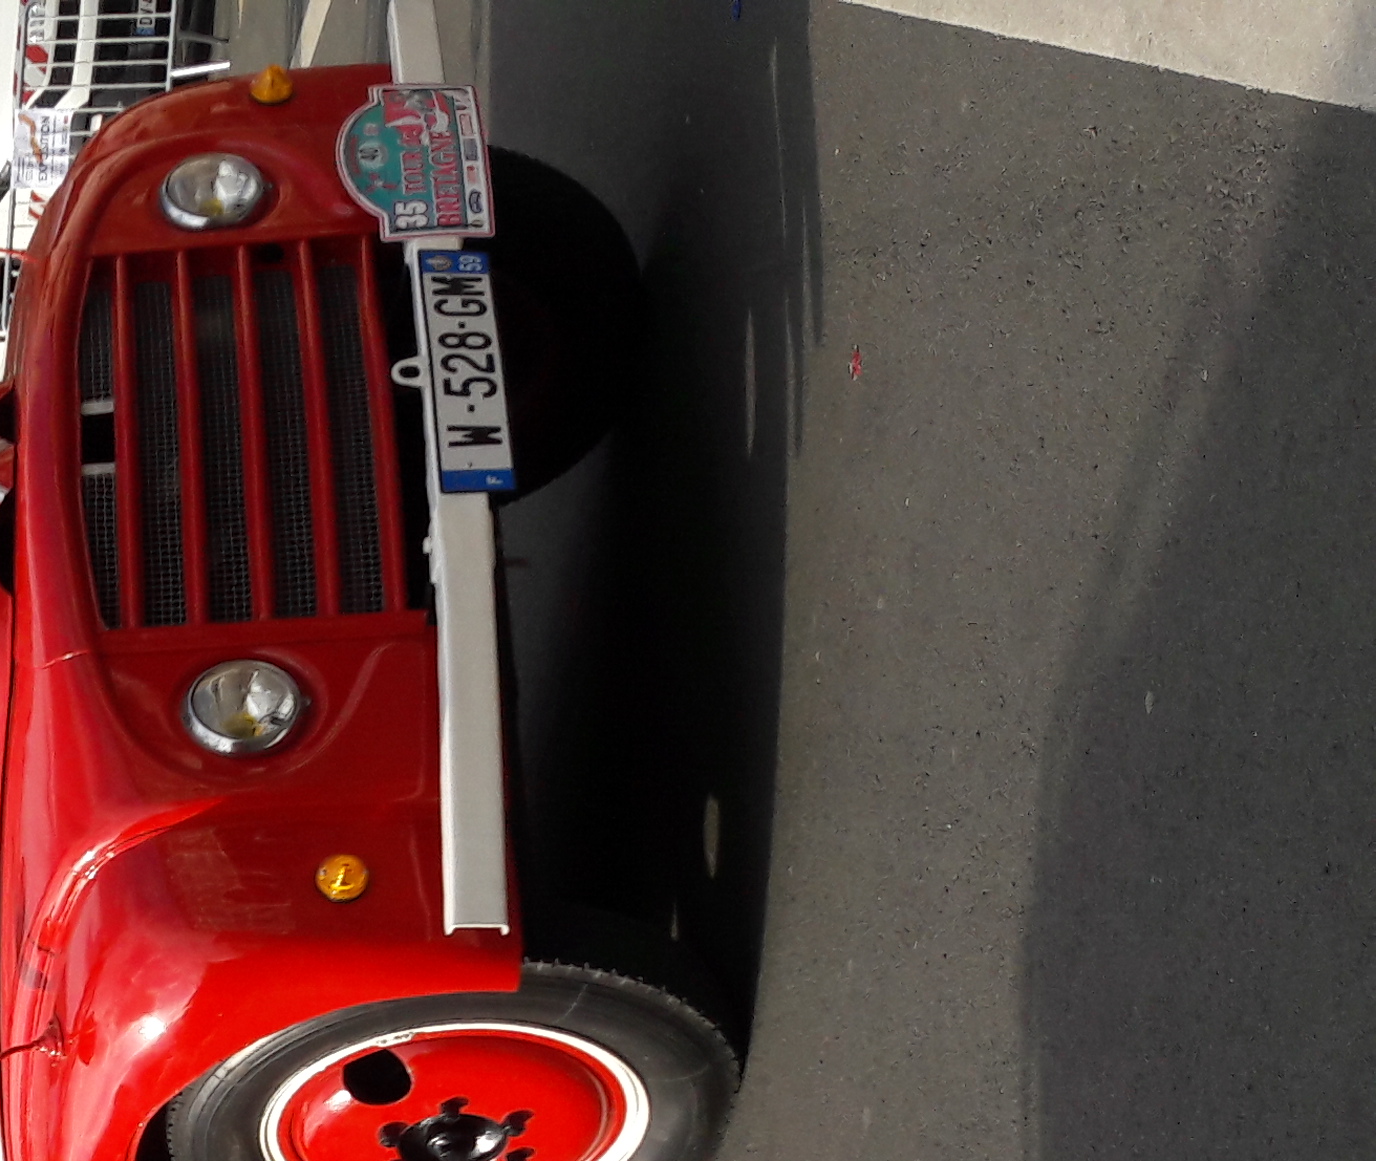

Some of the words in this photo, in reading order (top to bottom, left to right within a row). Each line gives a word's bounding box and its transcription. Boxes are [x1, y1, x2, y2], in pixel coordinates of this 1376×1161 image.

[400, 148, 427, 194] TOUR
[428, 129, 463, 227] BRETAGNE
[392, 199, 428, 229] 35
[458, 254, 483, 271] 59
[486, 475, 503, 486] F
